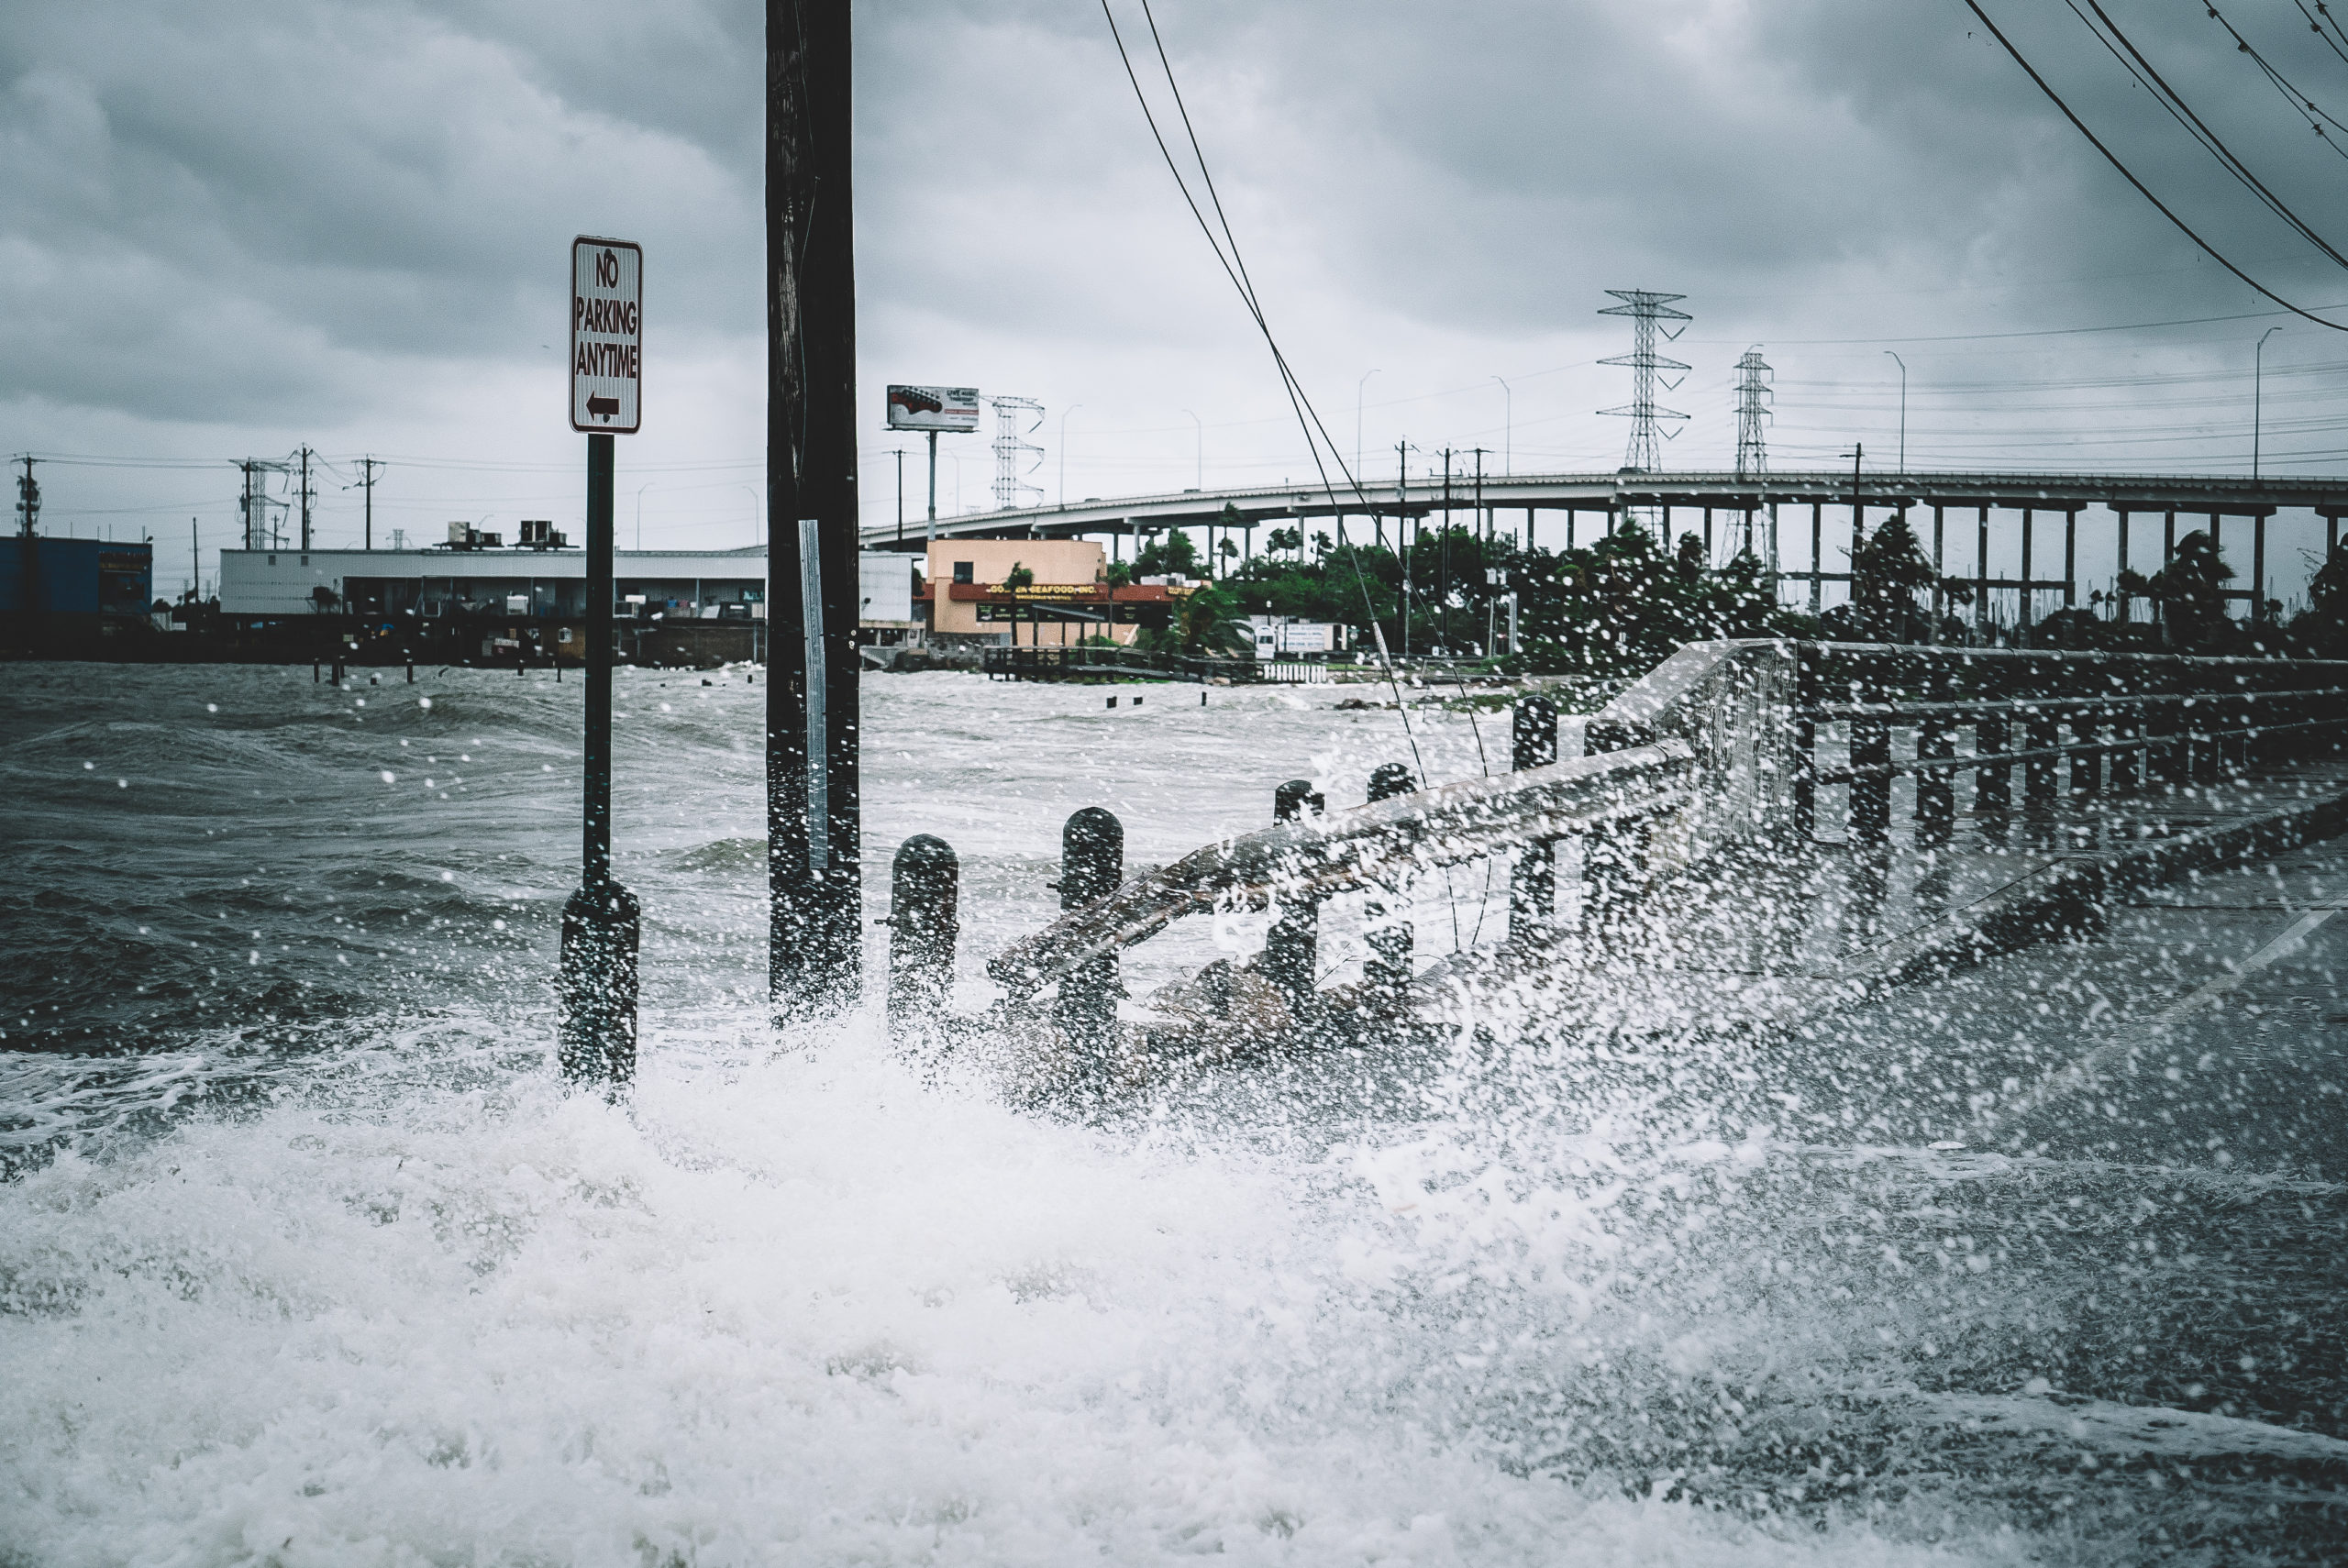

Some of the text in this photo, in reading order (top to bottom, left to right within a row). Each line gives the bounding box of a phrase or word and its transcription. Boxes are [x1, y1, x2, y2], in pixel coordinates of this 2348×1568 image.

[595, 252, 619, 289] NO
[576, 296, 637, 335] PARKING
[576, 341, 637, 379] ANYTIME
[990, 584, 1027, 593] GOEN
